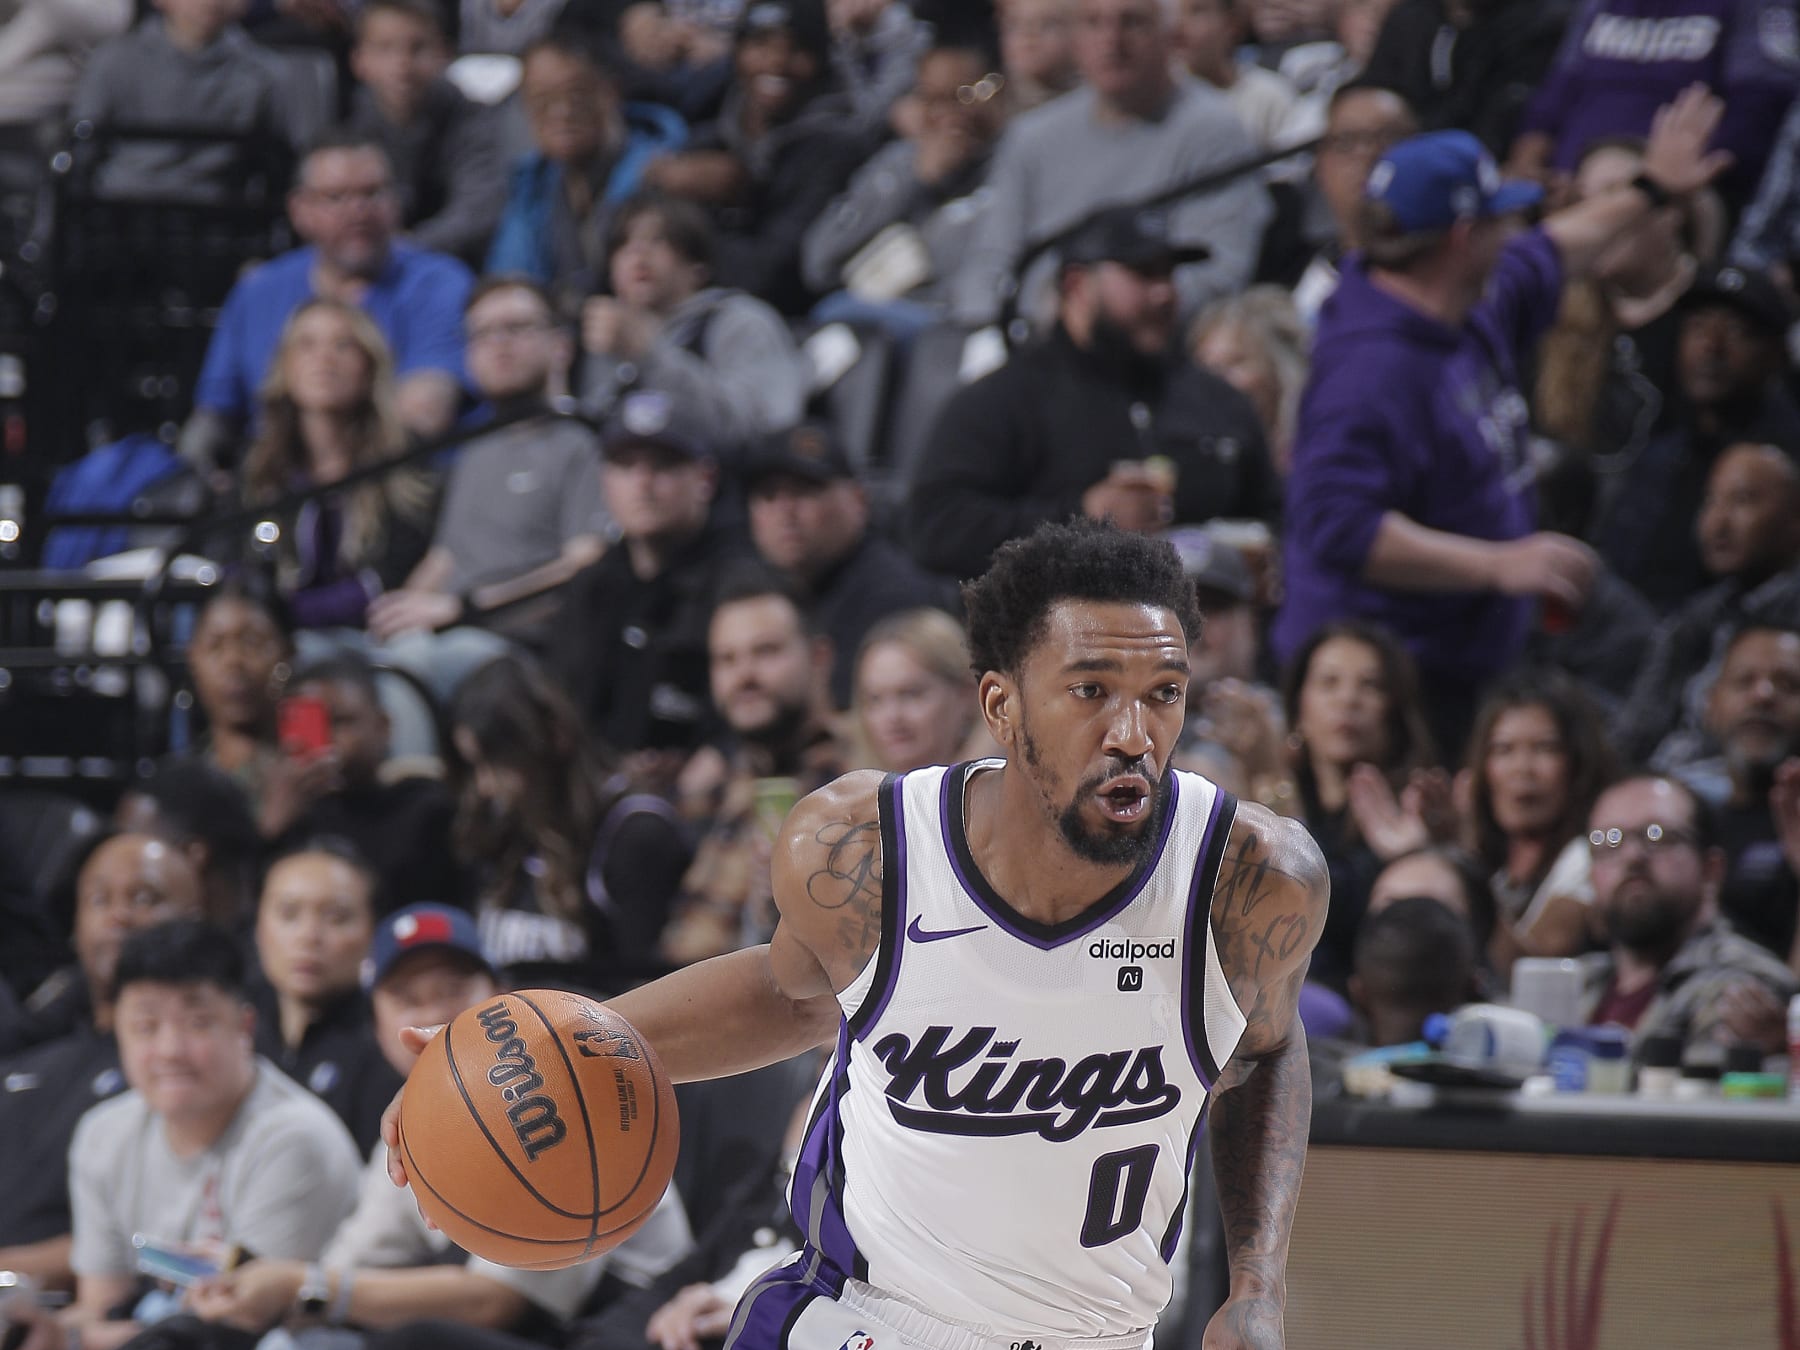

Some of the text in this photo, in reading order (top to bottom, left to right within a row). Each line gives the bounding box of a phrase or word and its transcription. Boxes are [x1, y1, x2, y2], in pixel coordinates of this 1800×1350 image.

[1088, 938, 1175, 963] dialpad
[476, 1001, 567, 1162] Wilson
[872, 1025, 1181, 1142] Kings
[1080, 1144, 1160, 1248] 0
